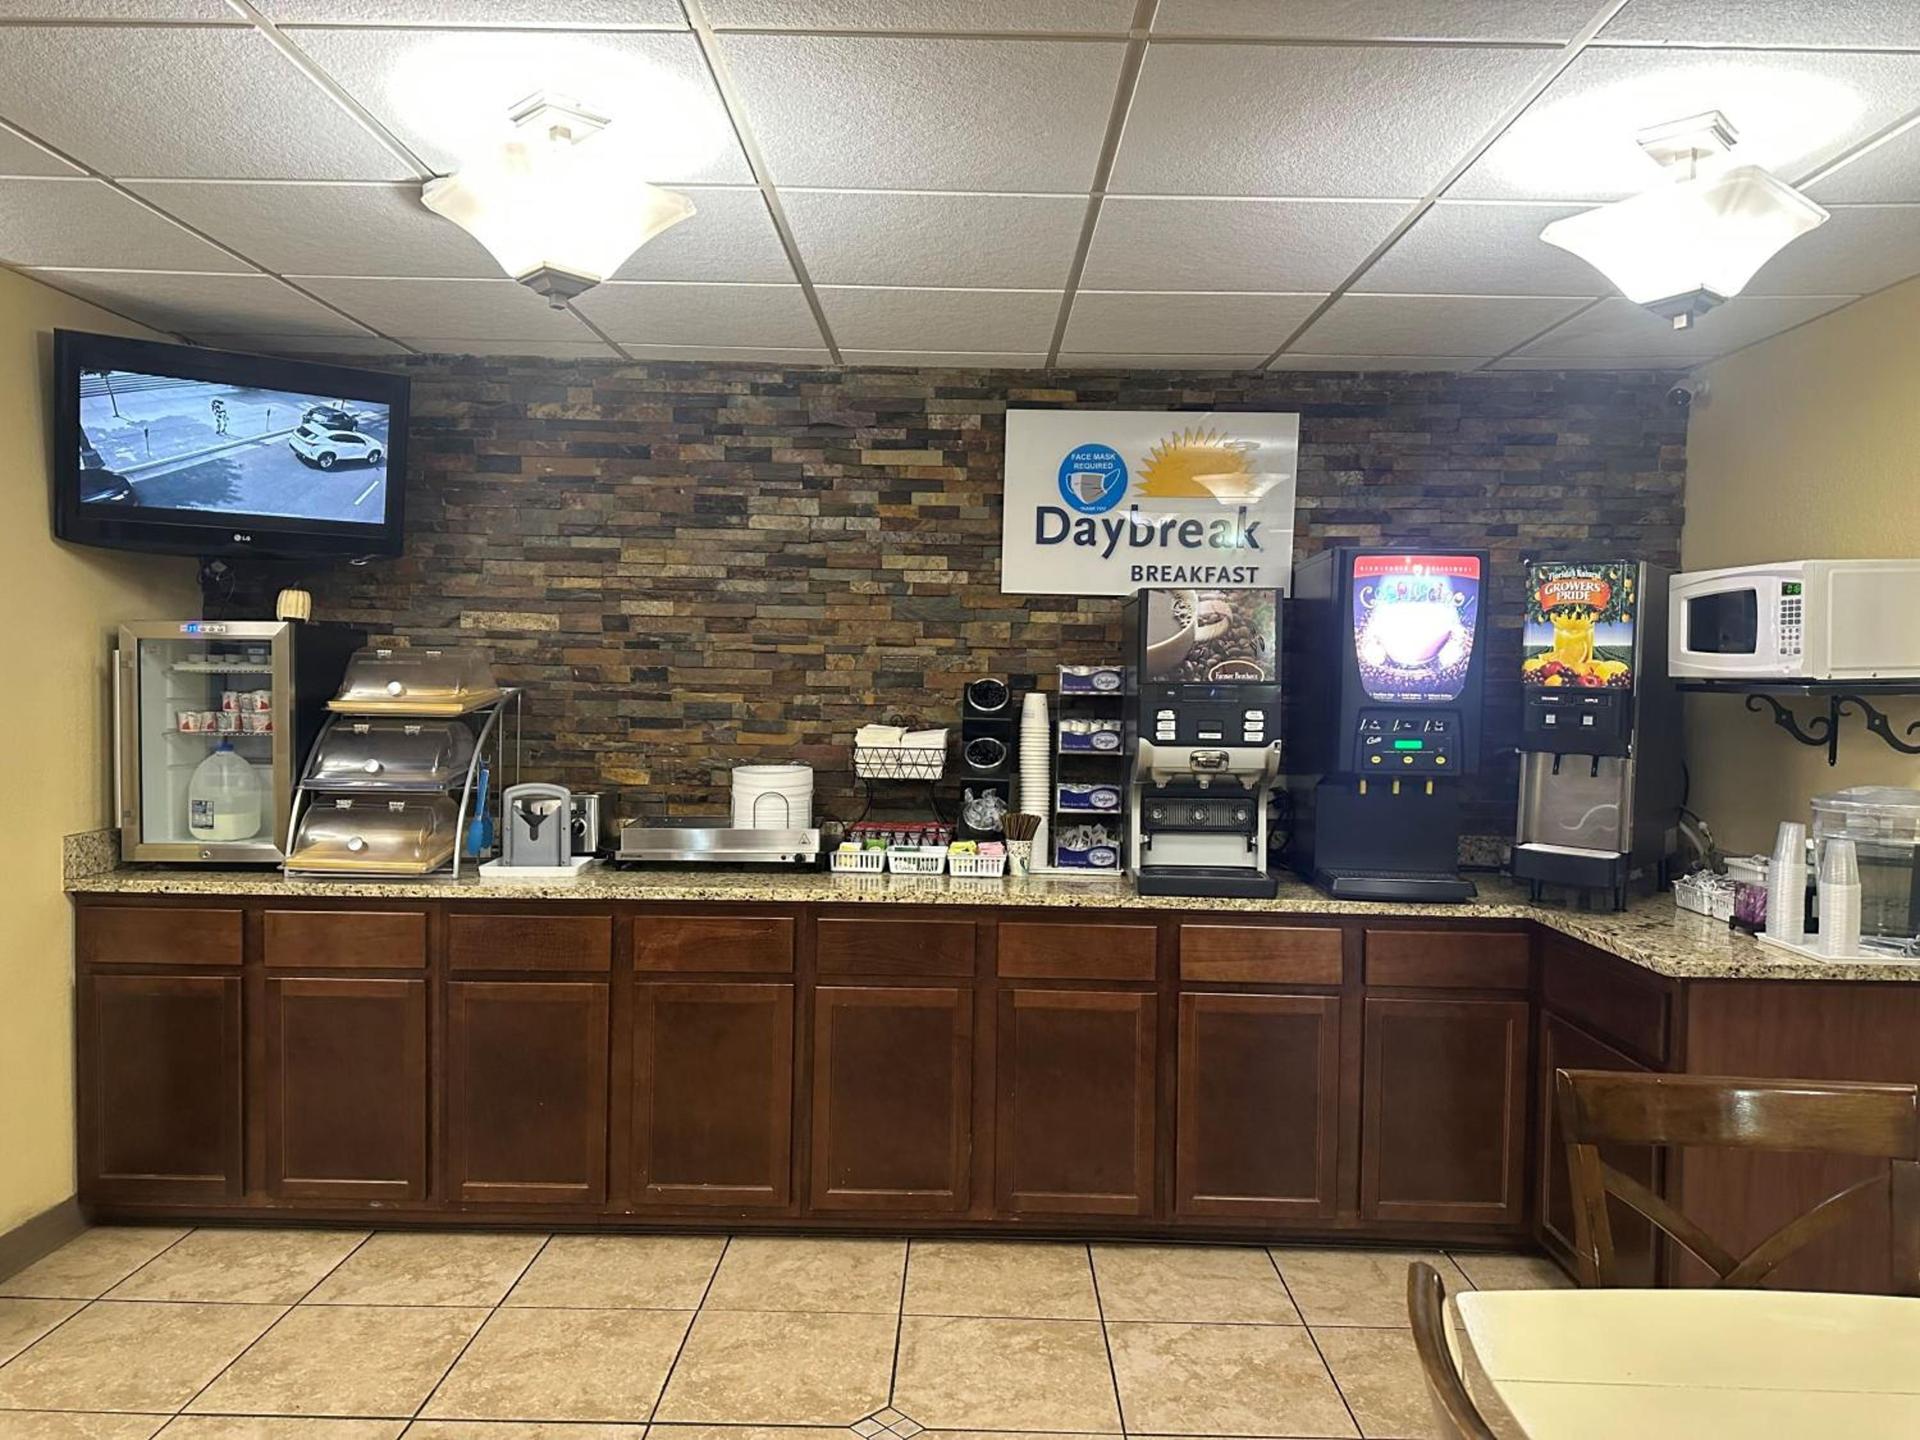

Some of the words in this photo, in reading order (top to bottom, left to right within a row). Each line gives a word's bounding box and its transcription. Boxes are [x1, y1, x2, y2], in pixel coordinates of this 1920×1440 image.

[1073, 462, 1114, 470] REQUIRED
[1036, 504, 1262, 559] Daybreak
[1131, 565, 1260, 583] BREAKFAST
[1545, 581, 1601, 595] GROWERS
[1556, 590, 1591, 601] PRIDE
